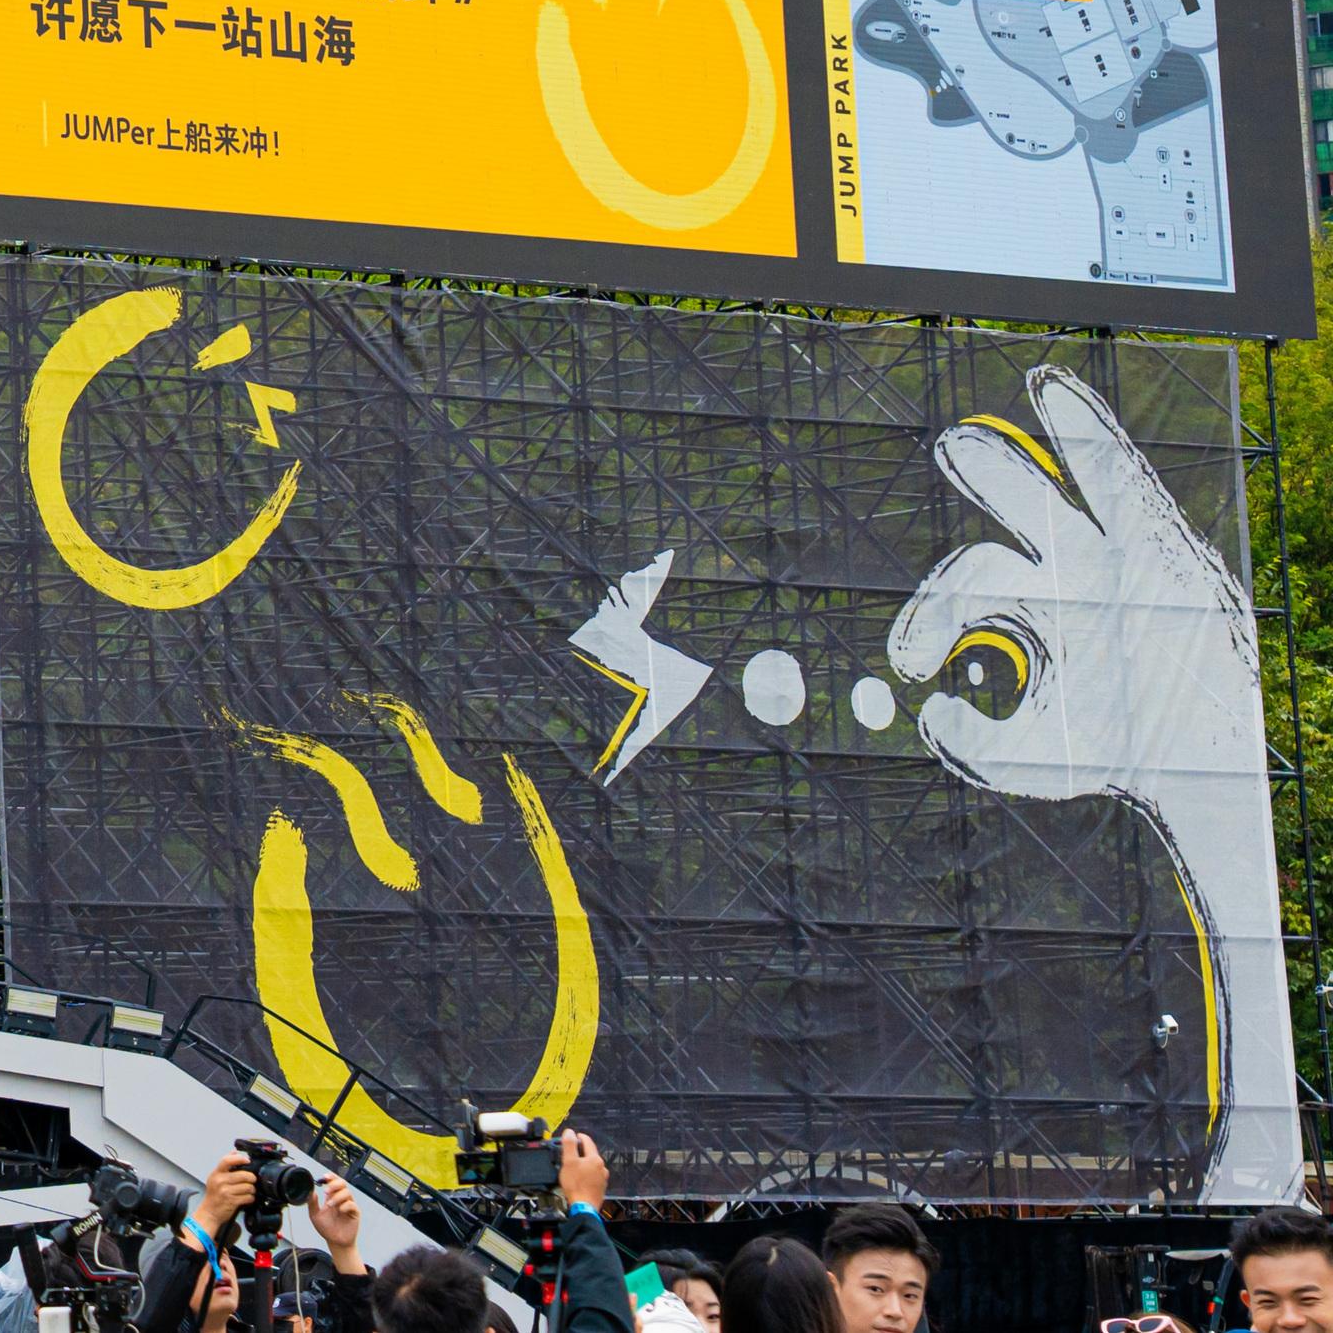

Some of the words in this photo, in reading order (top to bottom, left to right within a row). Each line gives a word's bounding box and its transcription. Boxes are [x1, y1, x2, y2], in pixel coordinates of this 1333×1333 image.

[831, 34, 851, 114] PARK
[837, 132, 858, 217] JUMP
[73, 1211, 103, 1236] RONIN
